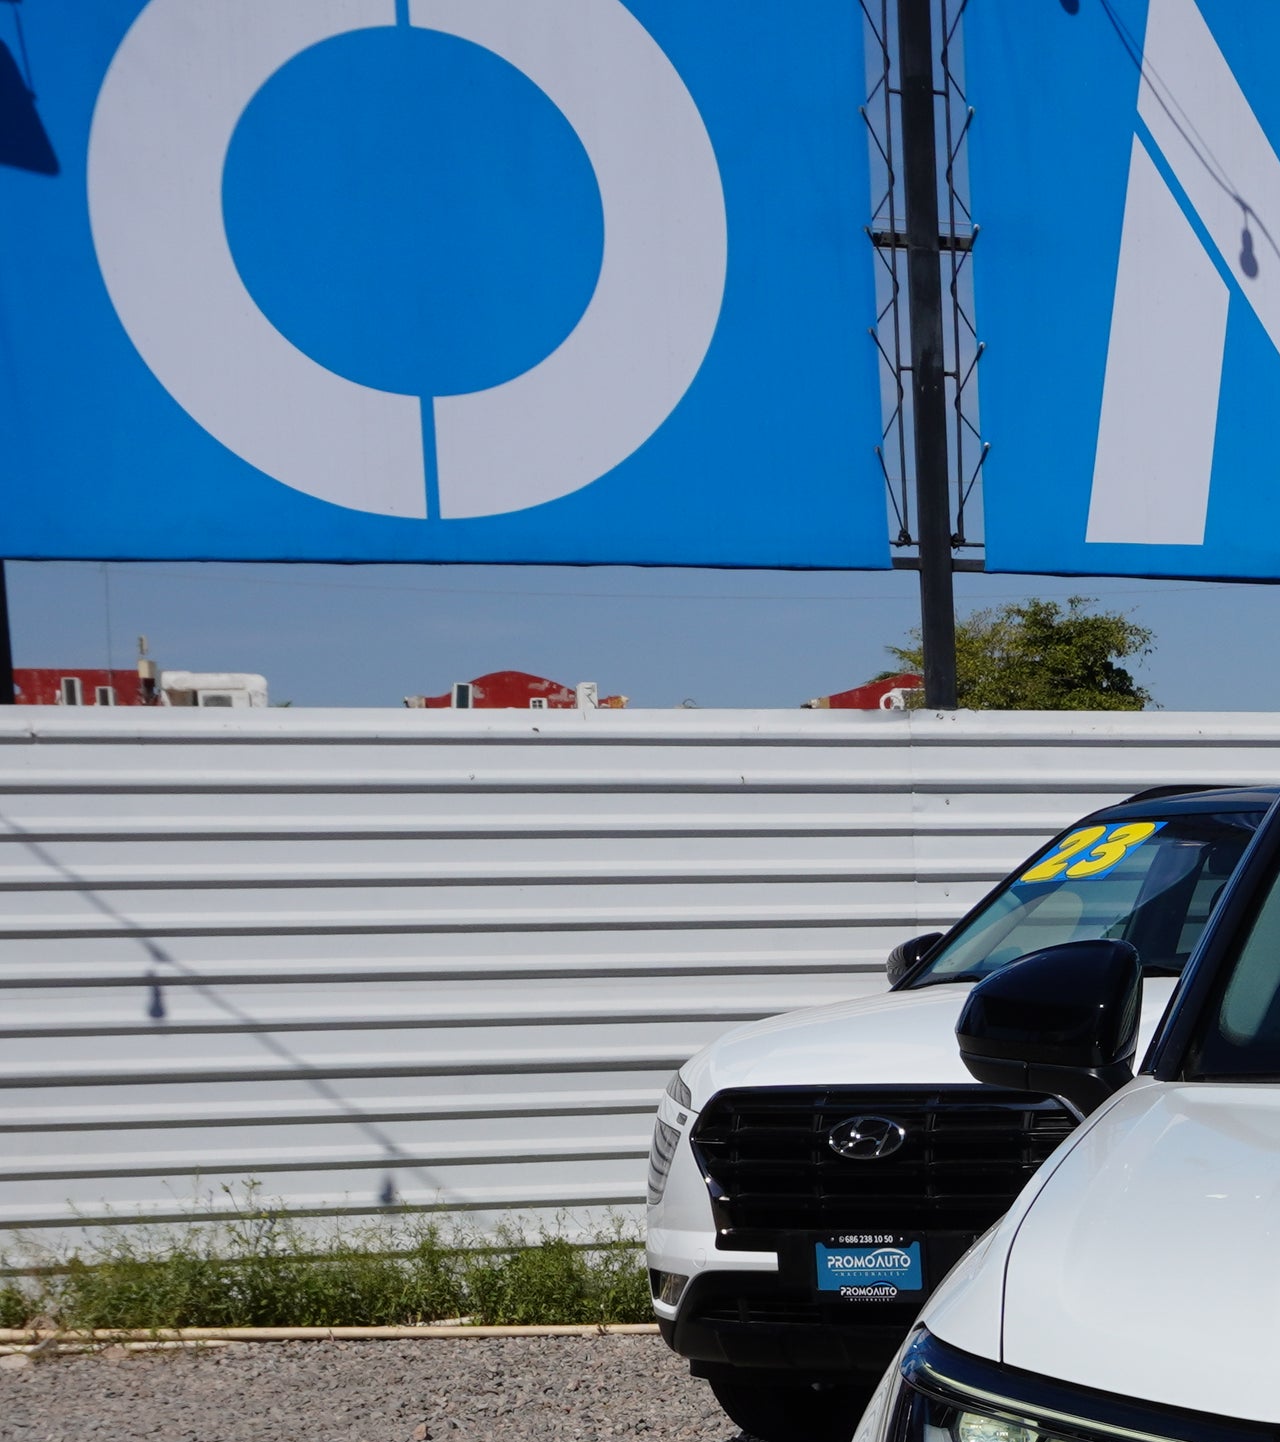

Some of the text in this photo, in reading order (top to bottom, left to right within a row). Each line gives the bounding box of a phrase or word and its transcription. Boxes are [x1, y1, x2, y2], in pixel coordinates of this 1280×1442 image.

[1019, 821, 1157, 883] 23
[845, 1235, 893, 1243] 686 238 10 50
[827, 1255, 911, 1269] PROMOAUTO
[840, 1286, 898, 1297] PROMOAUTO
